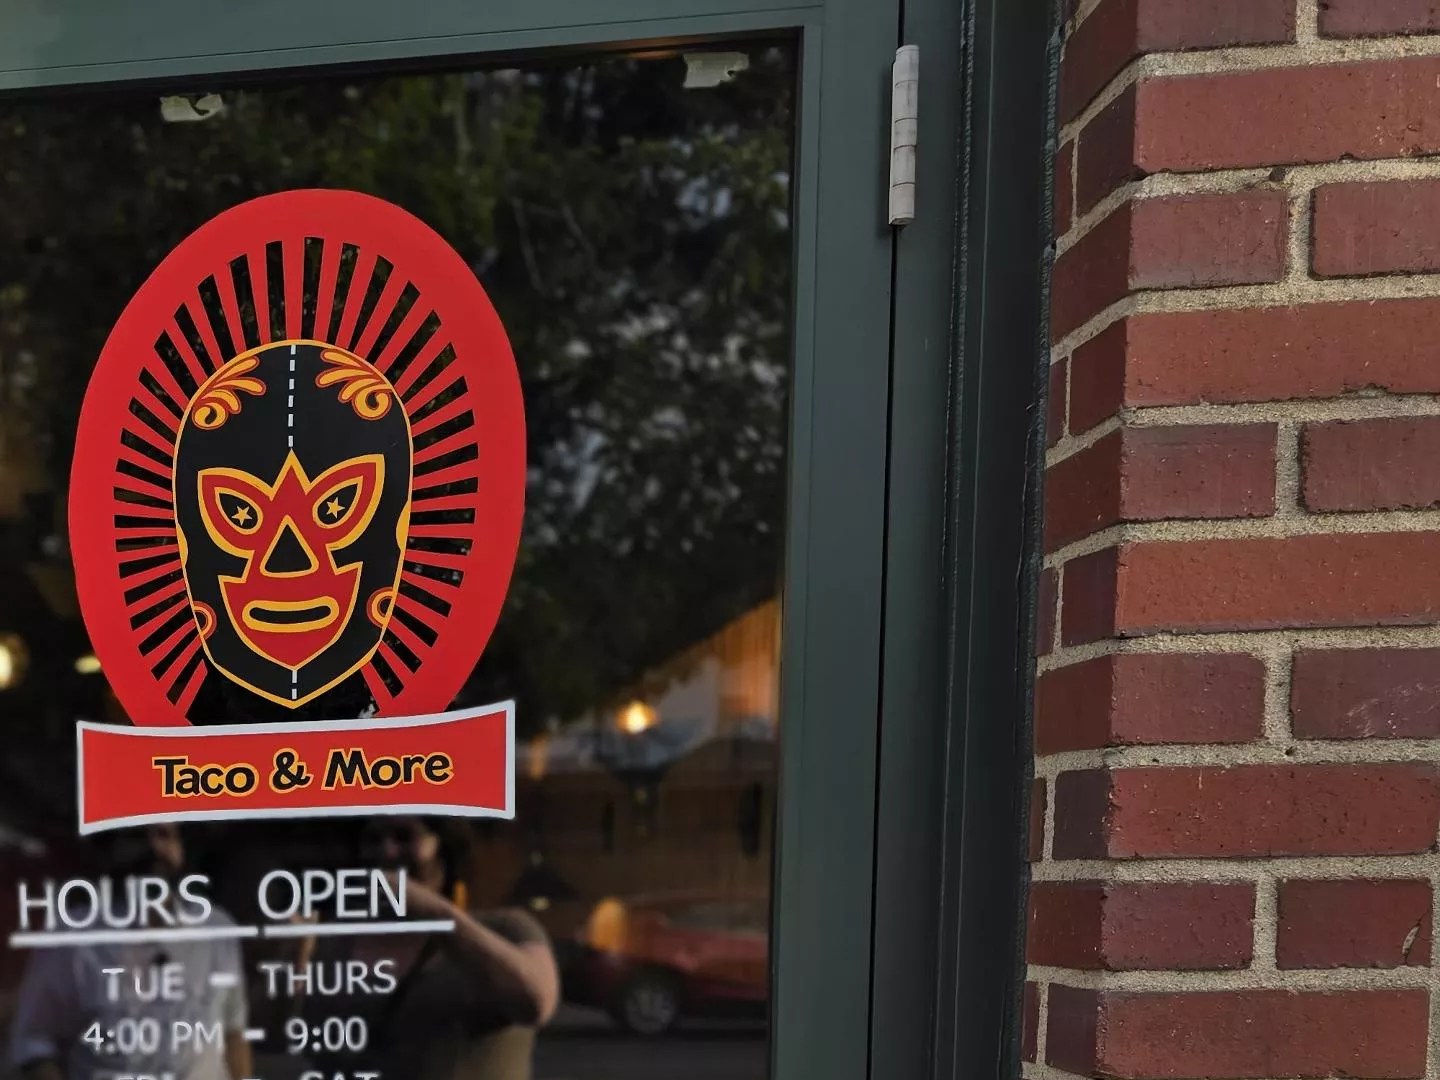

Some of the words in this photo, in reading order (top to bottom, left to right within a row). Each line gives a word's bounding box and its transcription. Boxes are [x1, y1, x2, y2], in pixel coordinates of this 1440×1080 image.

[152, 756, 259, 798] Taco
[269, 748, 314, 794] &
[321, 747, 454, 791] More
[18, 874, 212, 931] HOURS
[258, 868, 408, 921] OPEN
[101, 963, 187, 1002] TUE
[260, 958, 399, 998] THURS
[81, 1017, 161, 1054] 4:00
[170, 1020, 225, 1054] PM
[284, 1016, 368, 1054] 9:00
